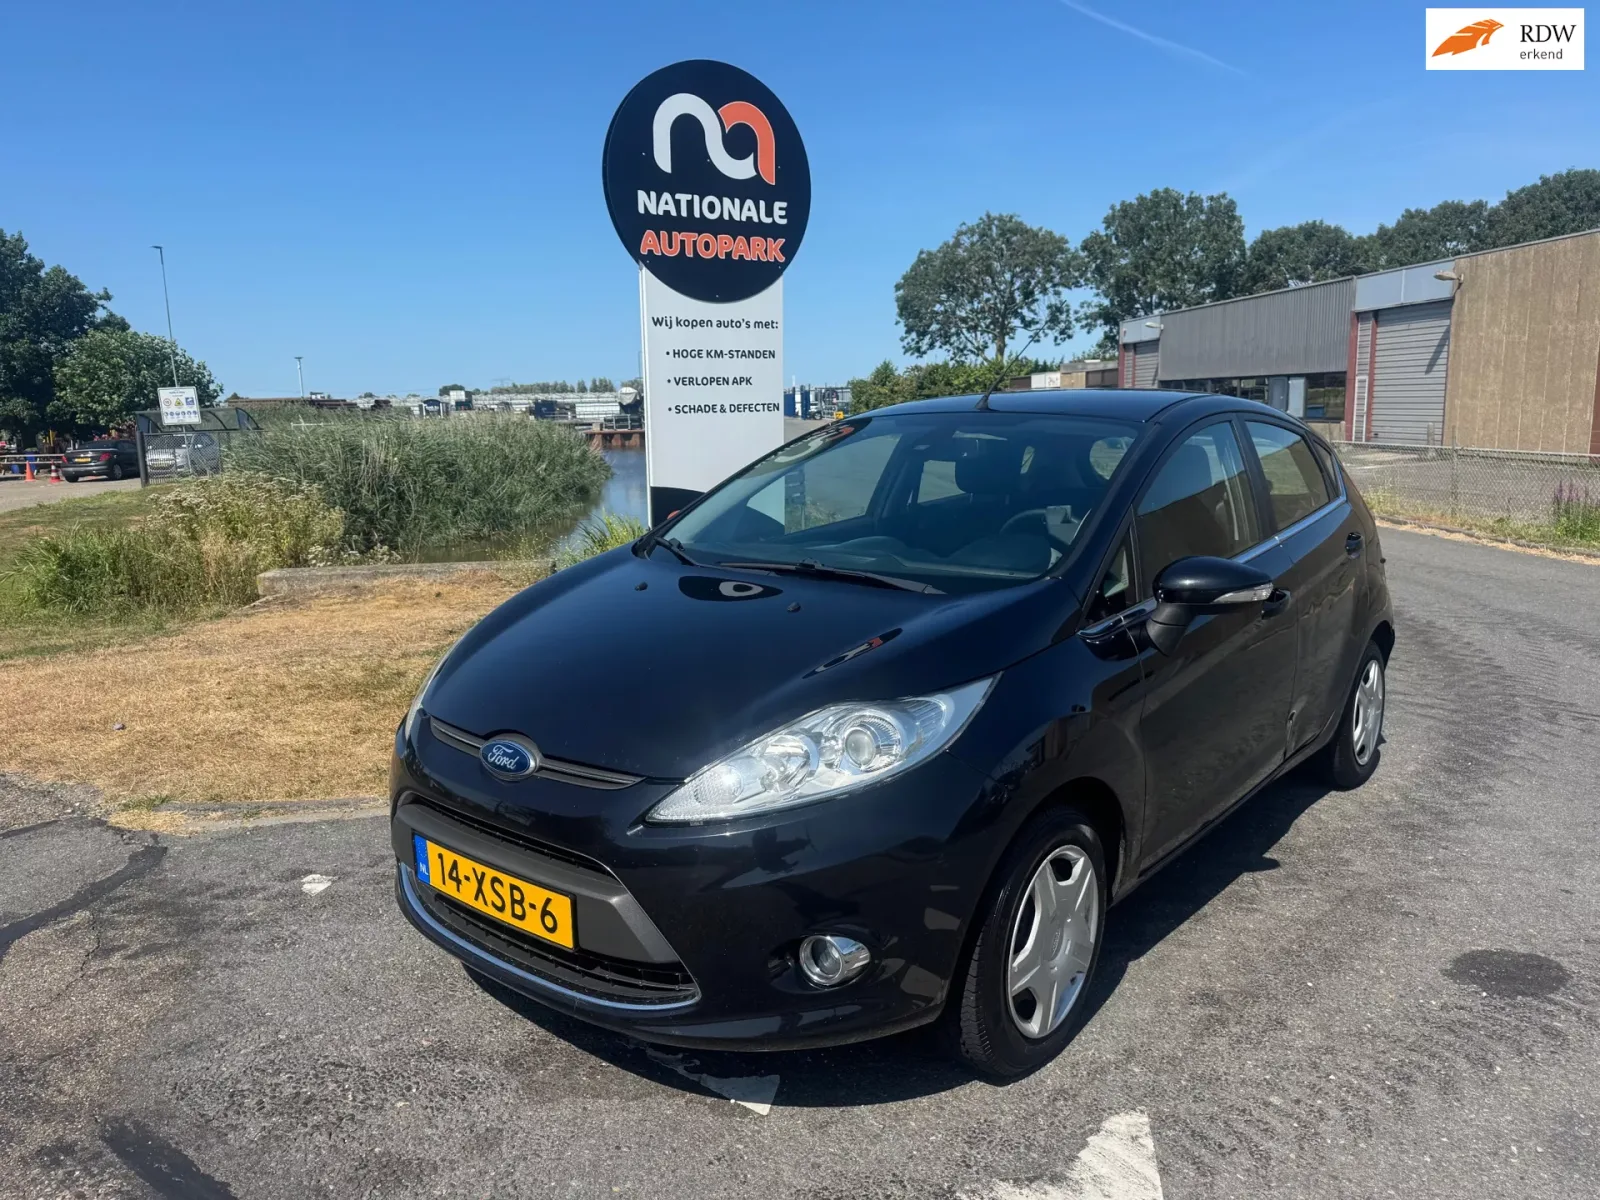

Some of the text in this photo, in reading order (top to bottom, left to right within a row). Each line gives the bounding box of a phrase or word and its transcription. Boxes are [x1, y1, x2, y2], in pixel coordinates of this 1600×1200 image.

[637, 189, 788, 225] NATIONALE
[640, 229, 786, 262] AUTOPARK
[651, 316, 779, 330] Wij kopen auto's met:
[672, 348, 776, 359] HOGE KM-STANDEN
[673, 376, 753, 386] VERLOPEN APK
[674, 402, 780, 414] SCHADE & DEFECTEN
[486, 743, 518, 771] Ford
[419, 861, 429, 876] NL
[437, 852, 559, 935] 14-XSB-6
